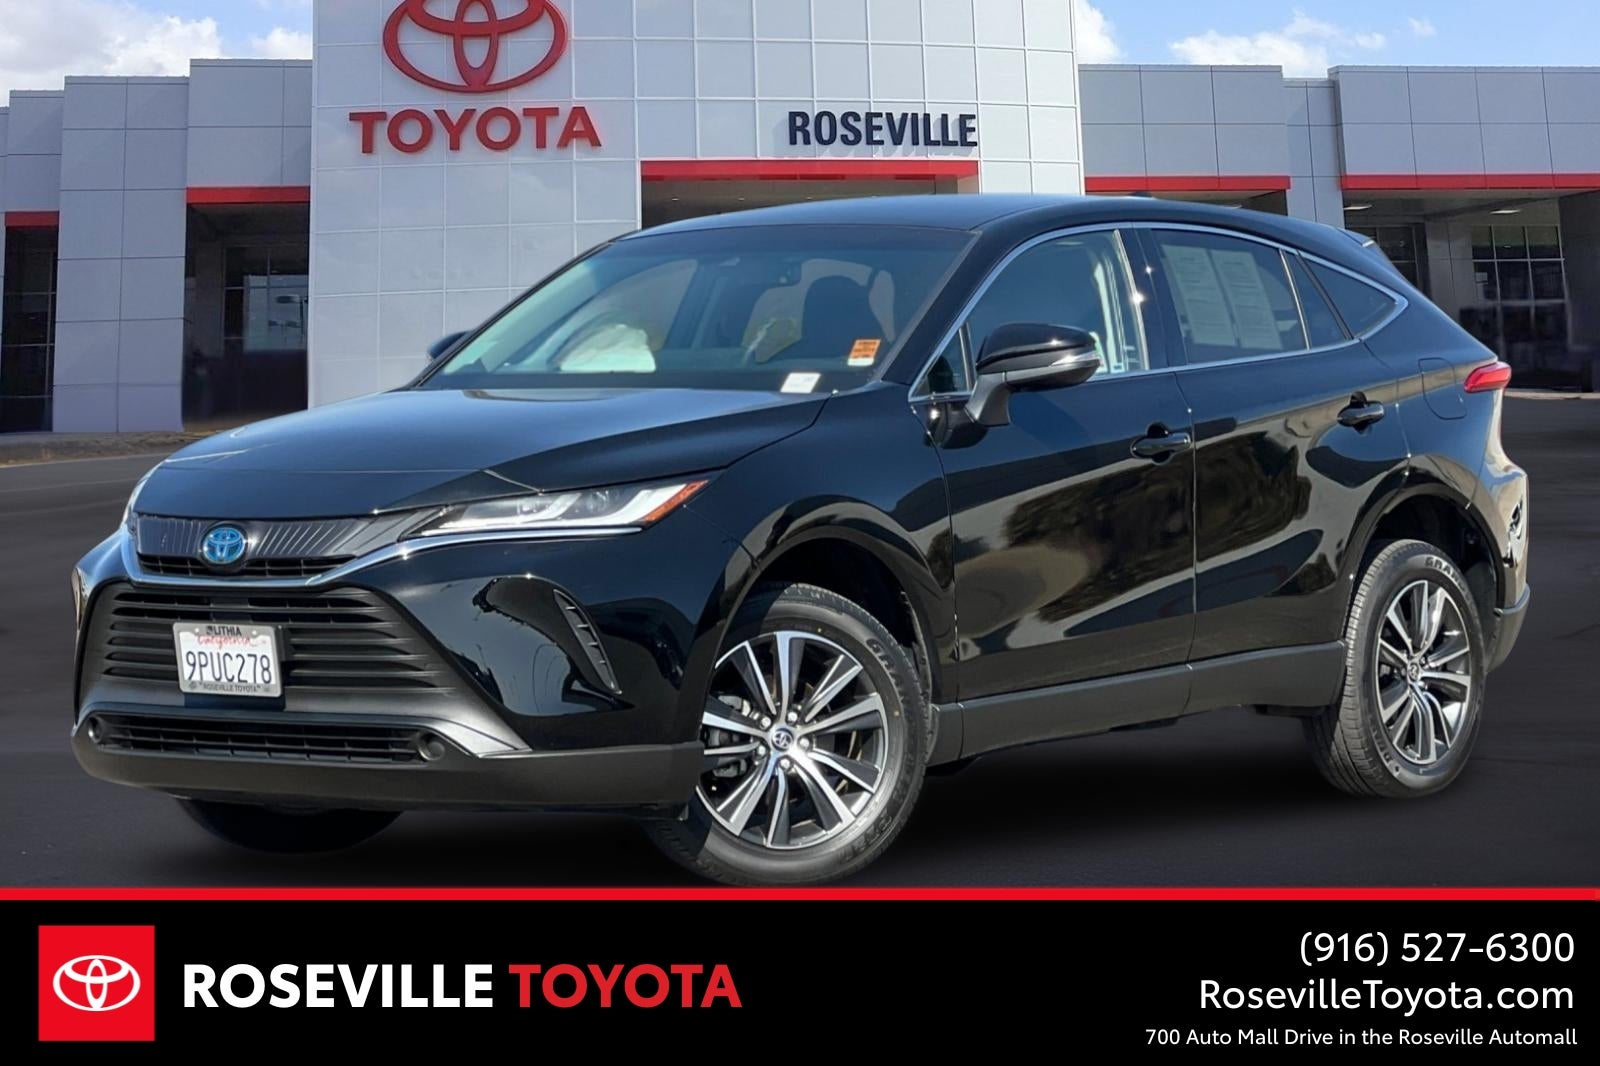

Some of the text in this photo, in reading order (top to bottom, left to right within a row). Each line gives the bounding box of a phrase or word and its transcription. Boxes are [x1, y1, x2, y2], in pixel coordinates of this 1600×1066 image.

[349, 106, 602, 154] TOYOTA
[788, 110, 979, 147] ROSEVILLE
[214, 625, 243, 637] LITHIA
[185, 650, 272, 684] 9PUC278
